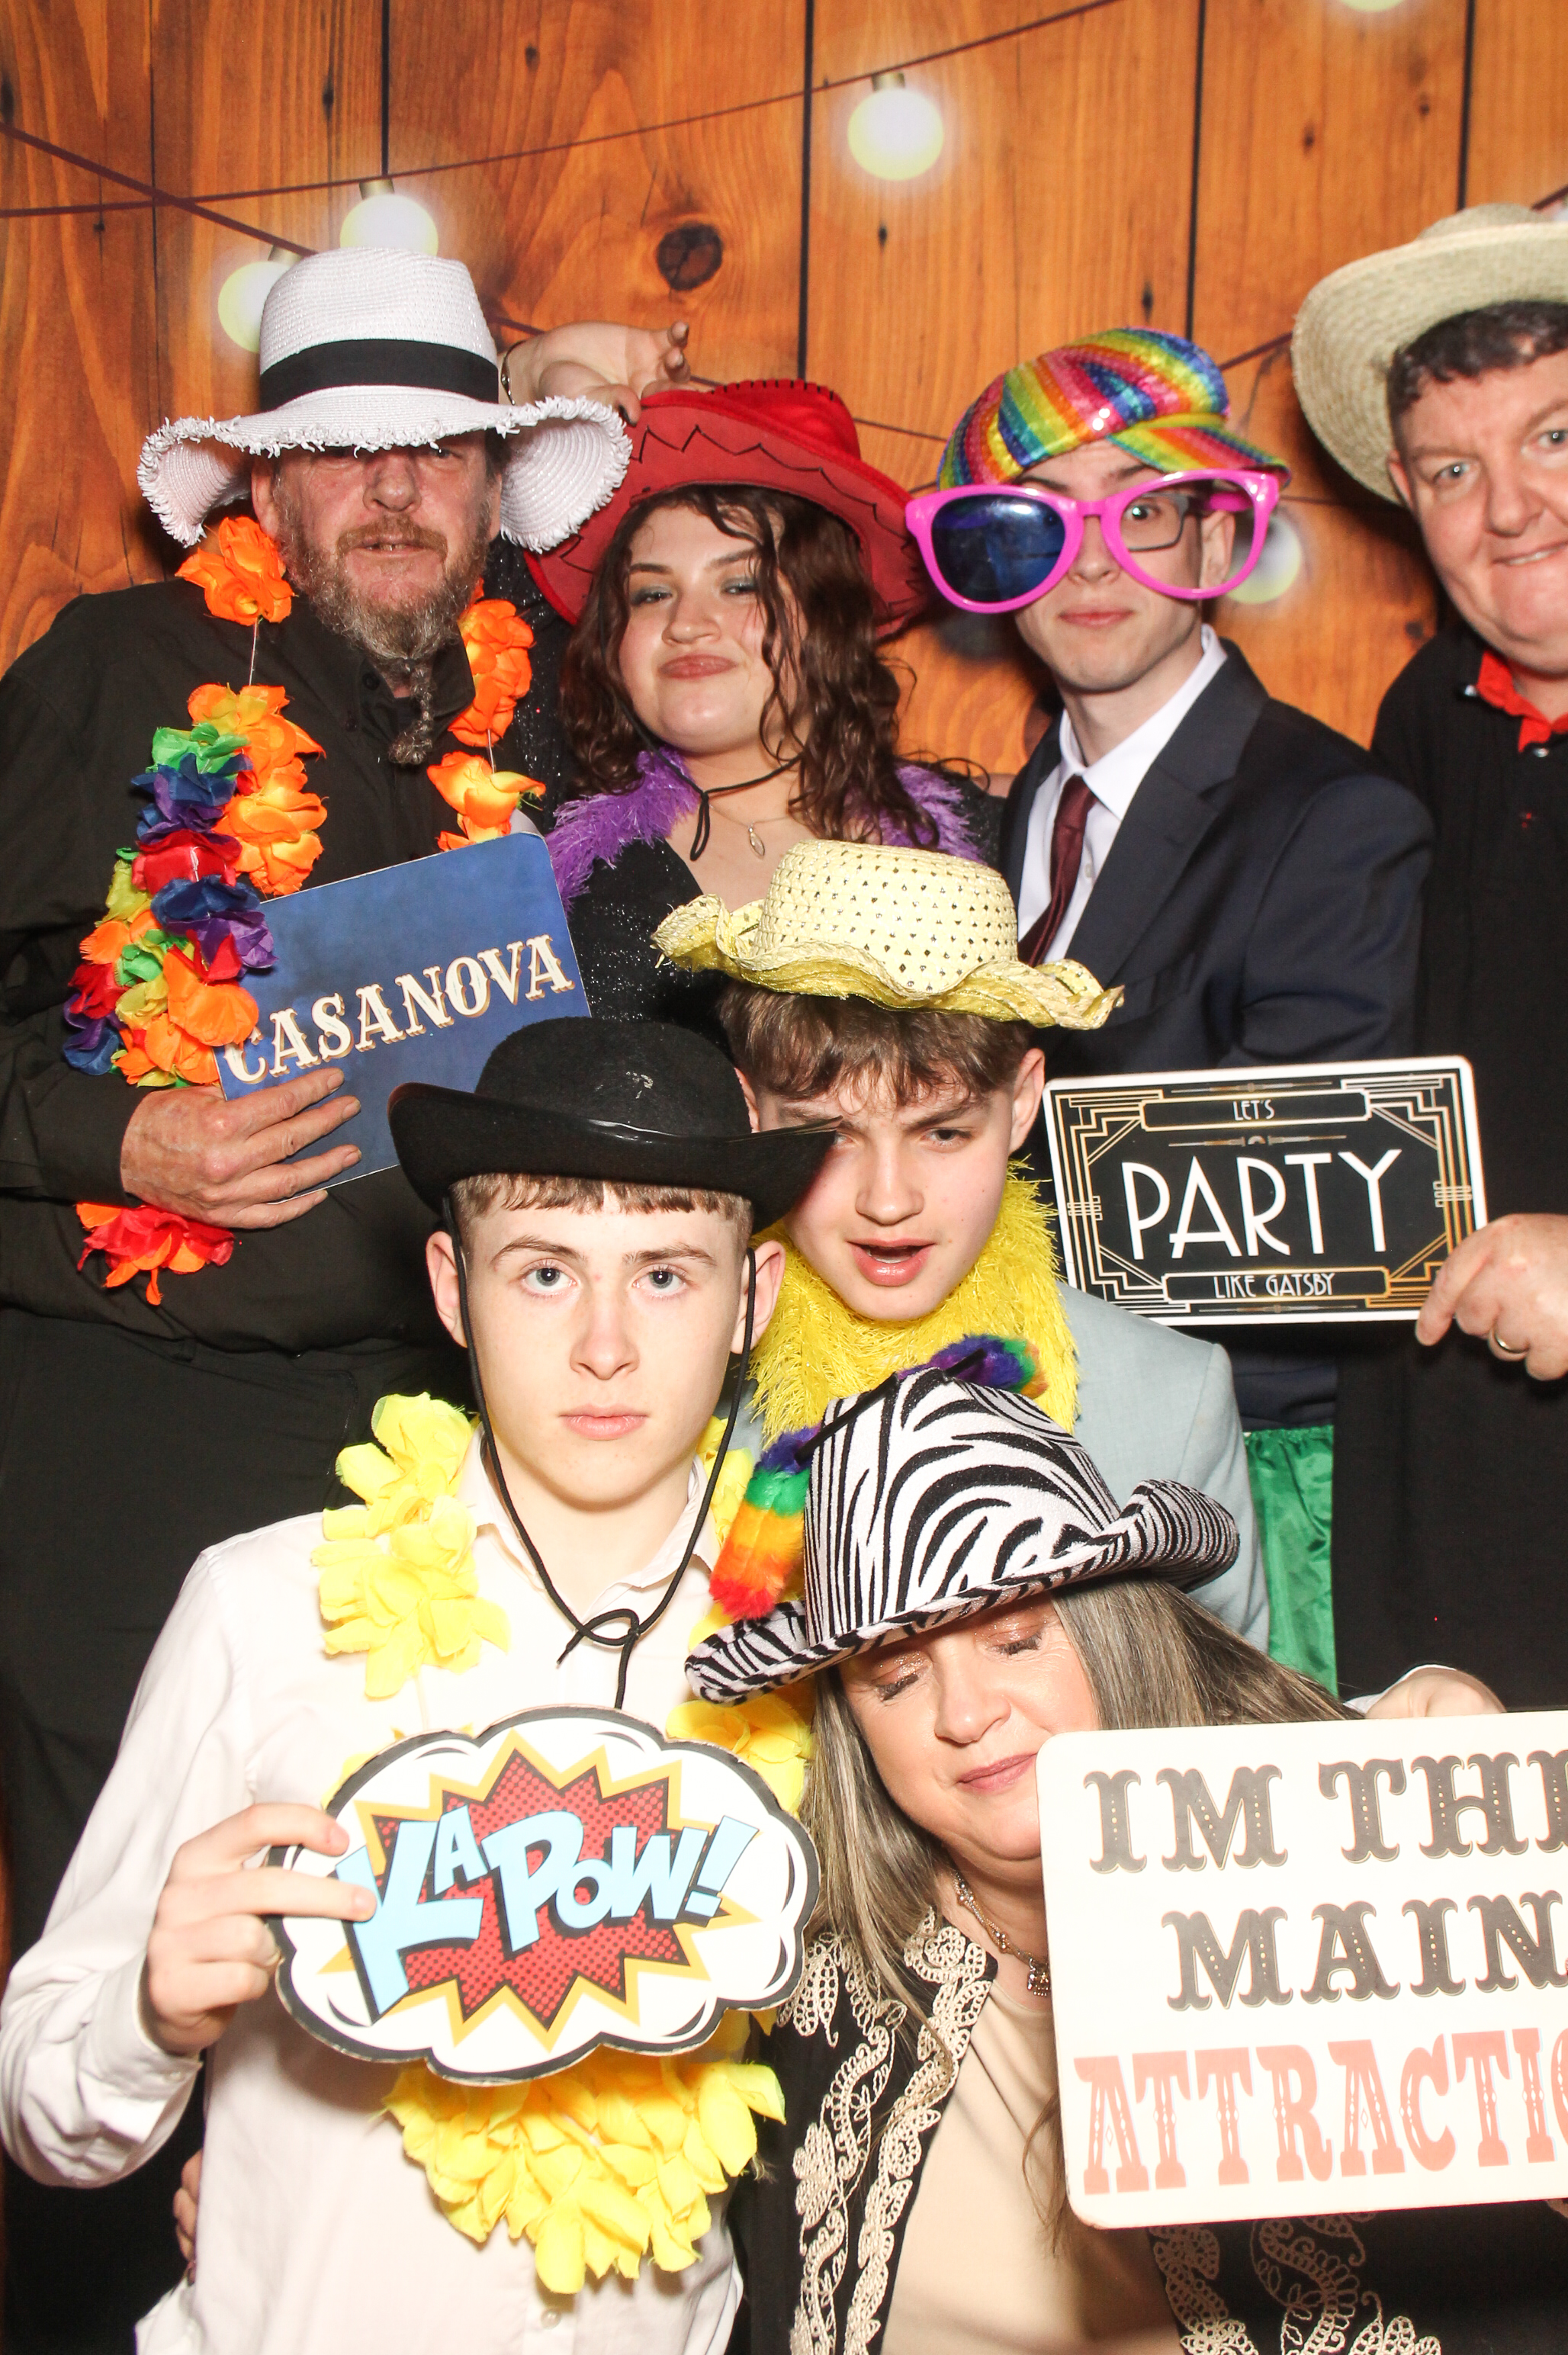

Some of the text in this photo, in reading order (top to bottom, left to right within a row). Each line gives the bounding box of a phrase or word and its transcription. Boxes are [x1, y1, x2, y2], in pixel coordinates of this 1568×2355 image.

[1232, 1099, 1275, 1121] LET'S
[1121, 1149, 1402, 1260] PARTY
[1213, 1271, 1336, 1299] LIKE GATSBY
[336, 1804, 760, 2015] KAPOW!
[1161, 1890, 1568, 2011] MAIN
[1073, 2028, 1568, 2196] ATTRACTI
